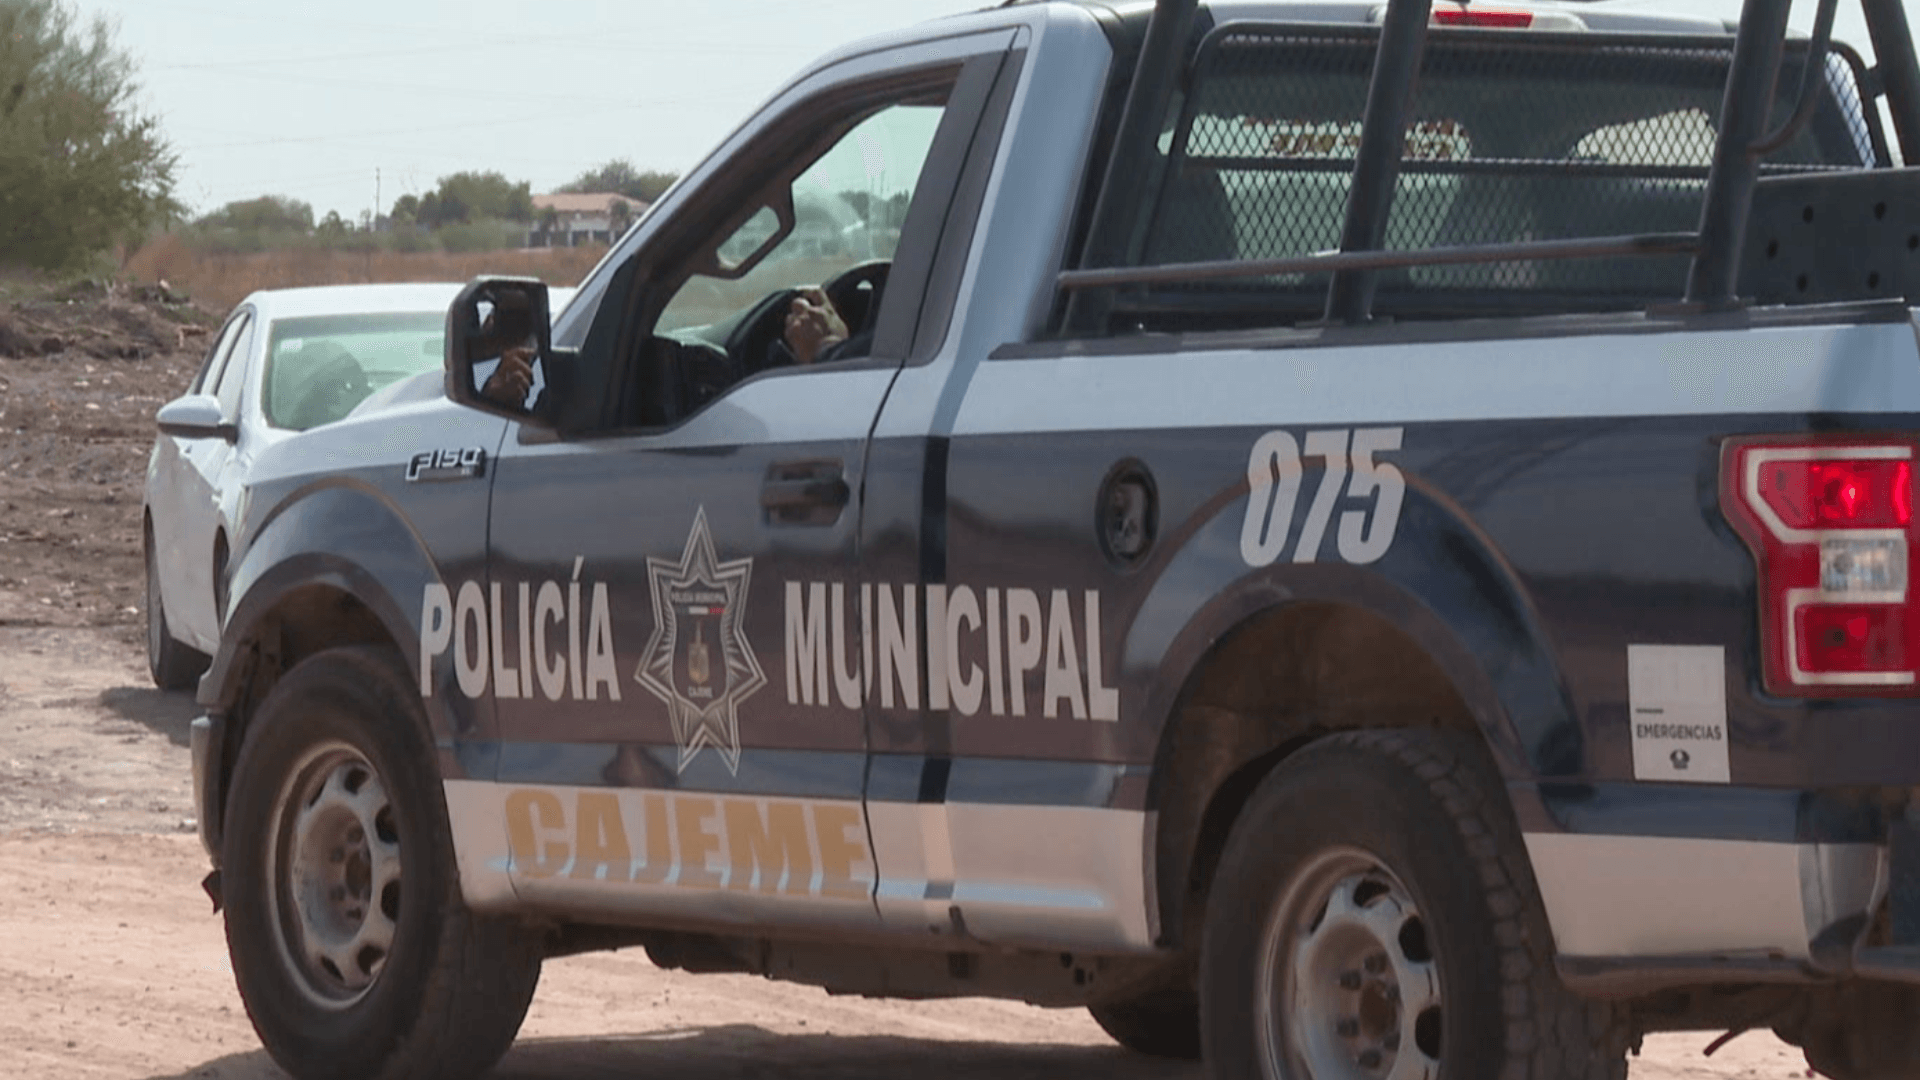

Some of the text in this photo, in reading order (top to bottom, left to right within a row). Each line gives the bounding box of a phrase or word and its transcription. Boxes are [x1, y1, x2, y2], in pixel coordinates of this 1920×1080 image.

[405, 447, 482, 481] F150
[1240, 427, 1405, 567] 075
[420, 556, 1119, 721] POLICÍA MUNICIPAL
[1636, 723, 1722, 740] EMERGENCIAS
[505, 789, 869, 899] CAJEME
